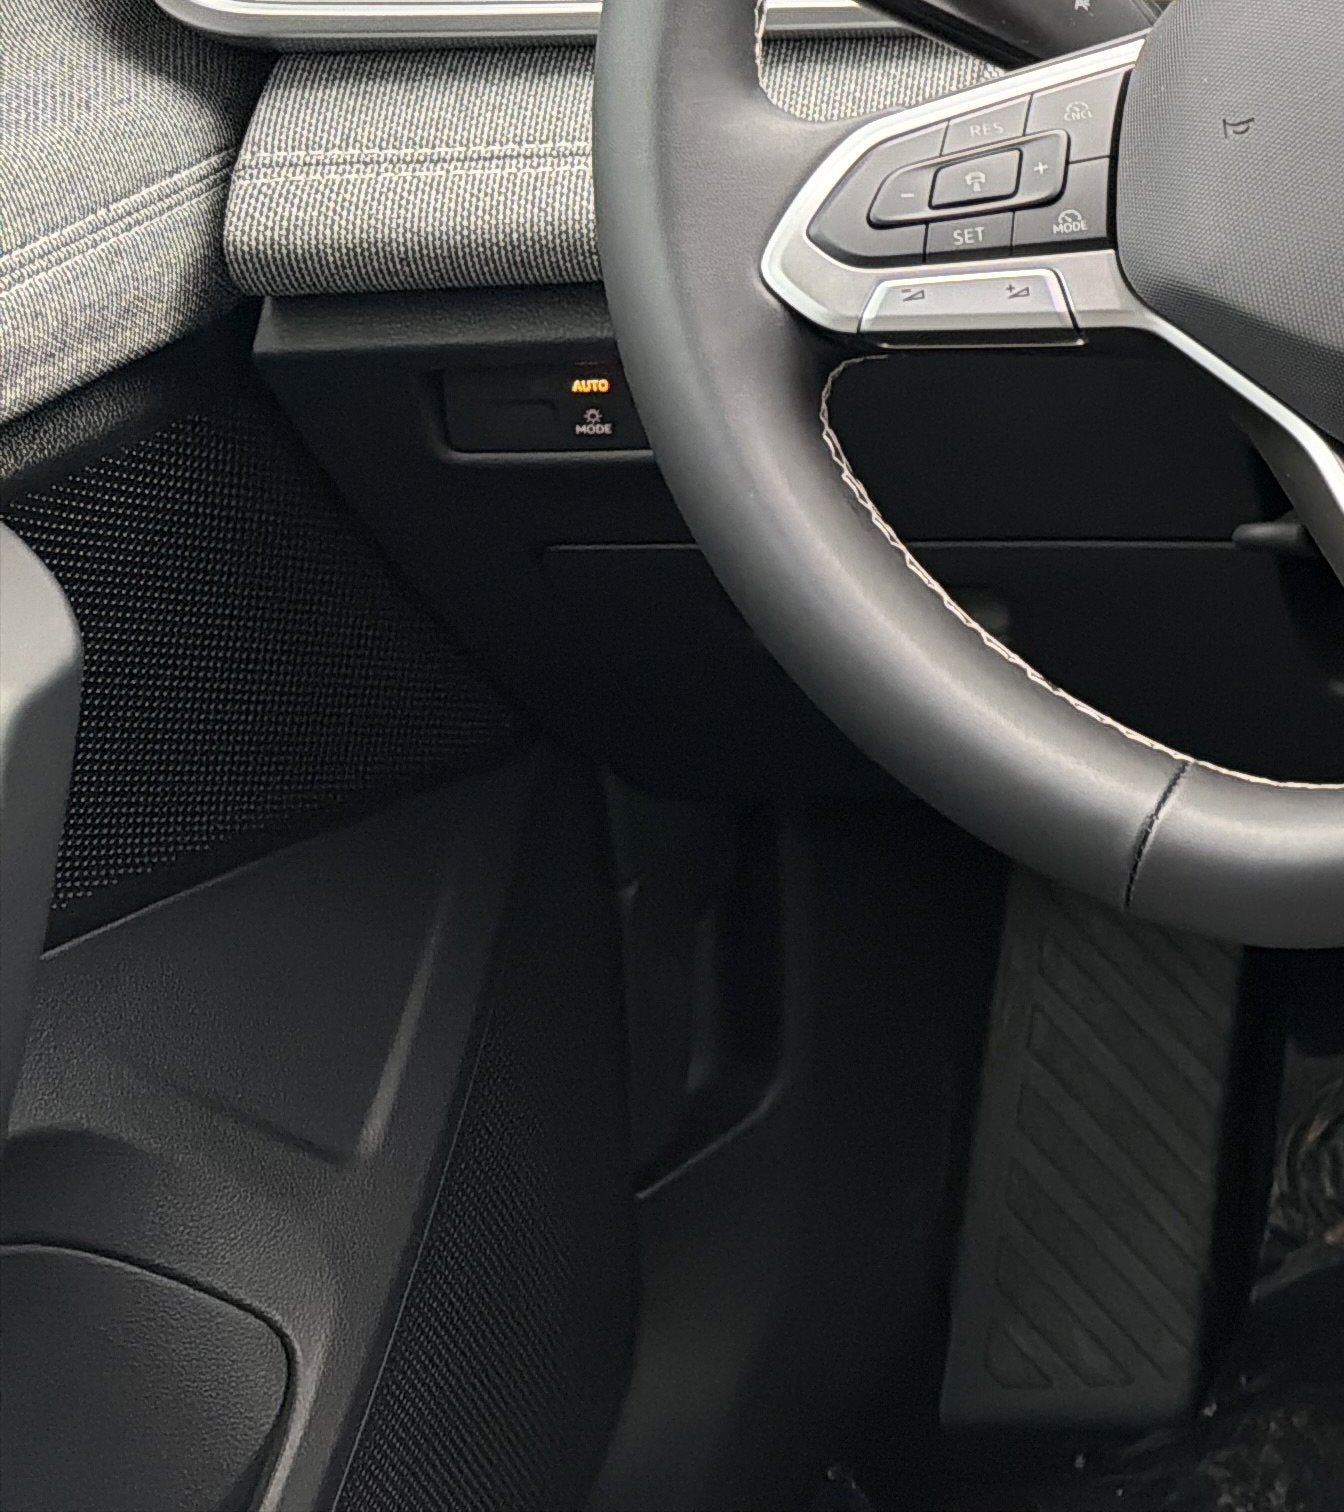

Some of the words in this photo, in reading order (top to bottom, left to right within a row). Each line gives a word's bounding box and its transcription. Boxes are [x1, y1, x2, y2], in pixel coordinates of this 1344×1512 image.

[969, 123, 1004, 137] RES
[1052, 218, 1089, 235] MODE
[952, 225, 985, 246] SET
[571, 378, 611, 393] AUTO
[575, 422, 613, 435] MODE
